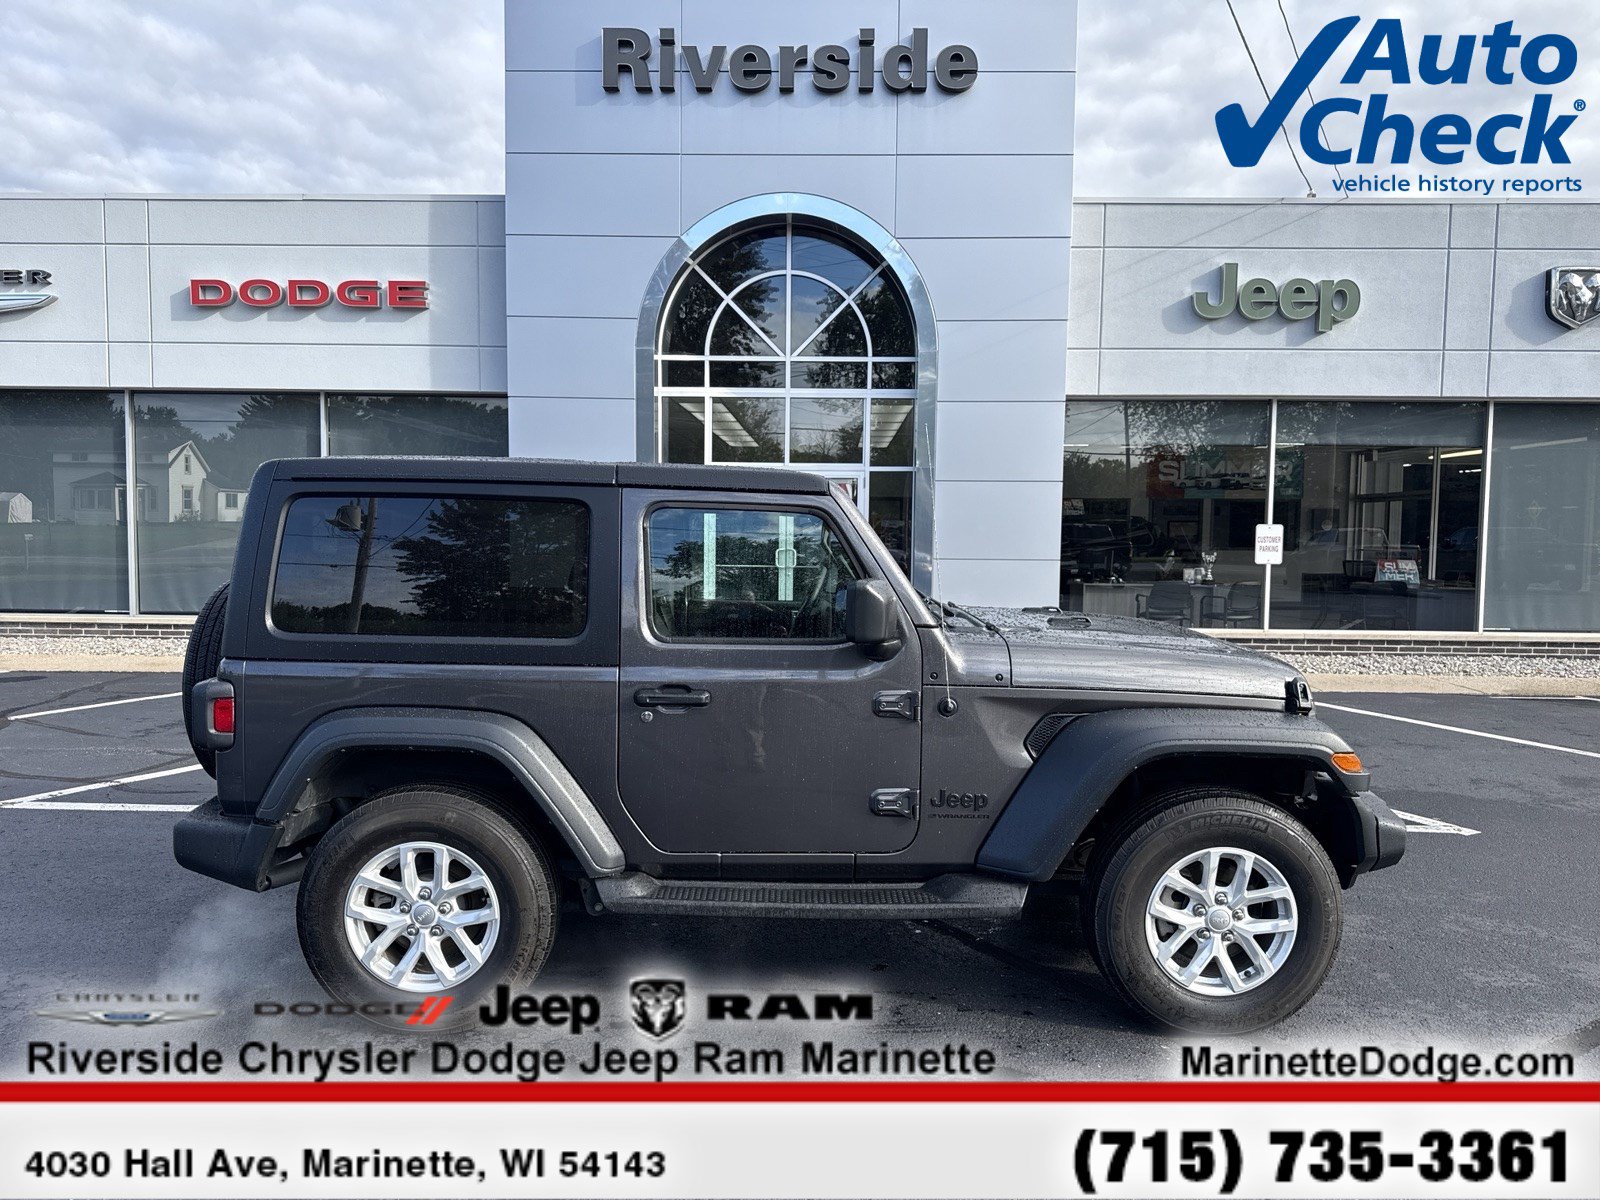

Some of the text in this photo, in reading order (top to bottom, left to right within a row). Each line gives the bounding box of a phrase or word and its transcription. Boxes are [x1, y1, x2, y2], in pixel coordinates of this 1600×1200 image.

[601, 27, 979, 94] Riverside
[189, 278, 430, 309] DODGE
[1192, 262, 1361, 333] Jeep
[1257, 535, 1281, 544] CUSTOMER
[1259, 545, 1279, 553] PARKING
[930, 789, 989, 811] Jeep
[1190, 814, 1269, 834] MICHELIN
